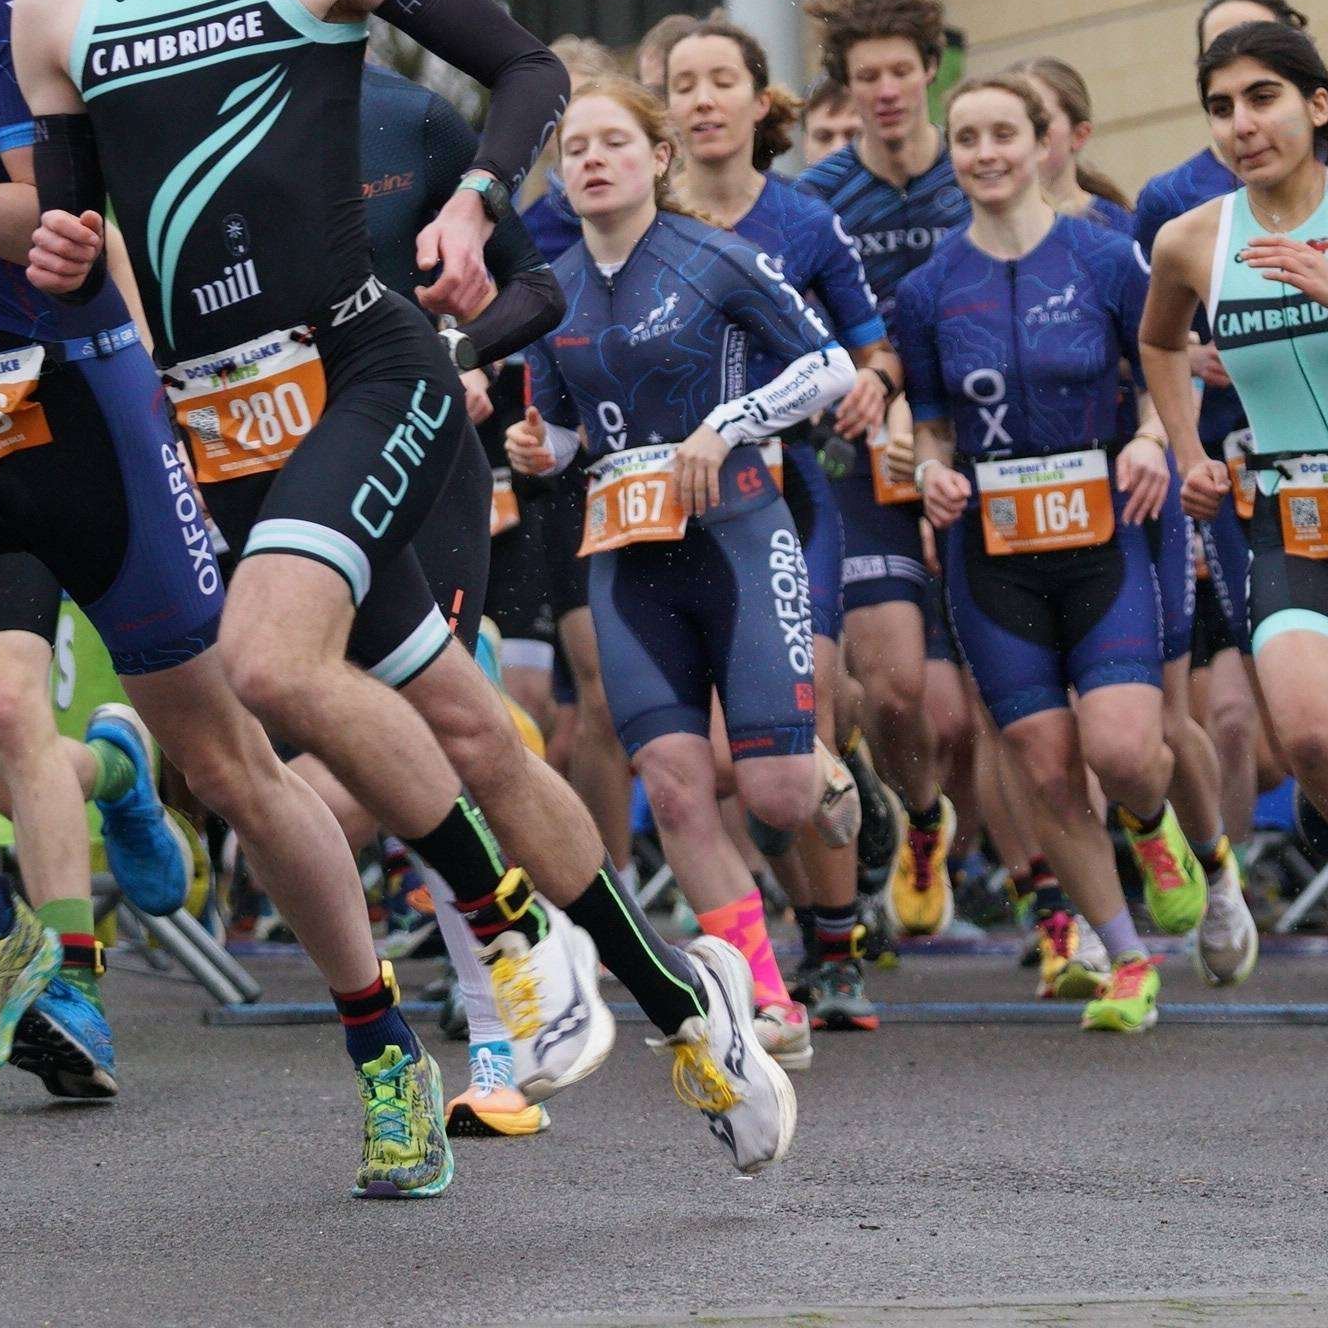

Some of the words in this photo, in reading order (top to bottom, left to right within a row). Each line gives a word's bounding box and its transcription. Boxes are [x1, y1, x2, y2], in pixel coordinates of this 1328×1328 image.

[92, 10, 265, 76] CAMBRIDGE
[191, 259, 263, 315] mill
[241, 342, 283, 365] LAKE
[229, 381, 313, 451] 280
[161, 443, 221, 596] OXFORD
[618, 480, 666, 529] 167
[1033, 488, 1090, 534] 164
[769, 528, 810, 675] OXFORD
